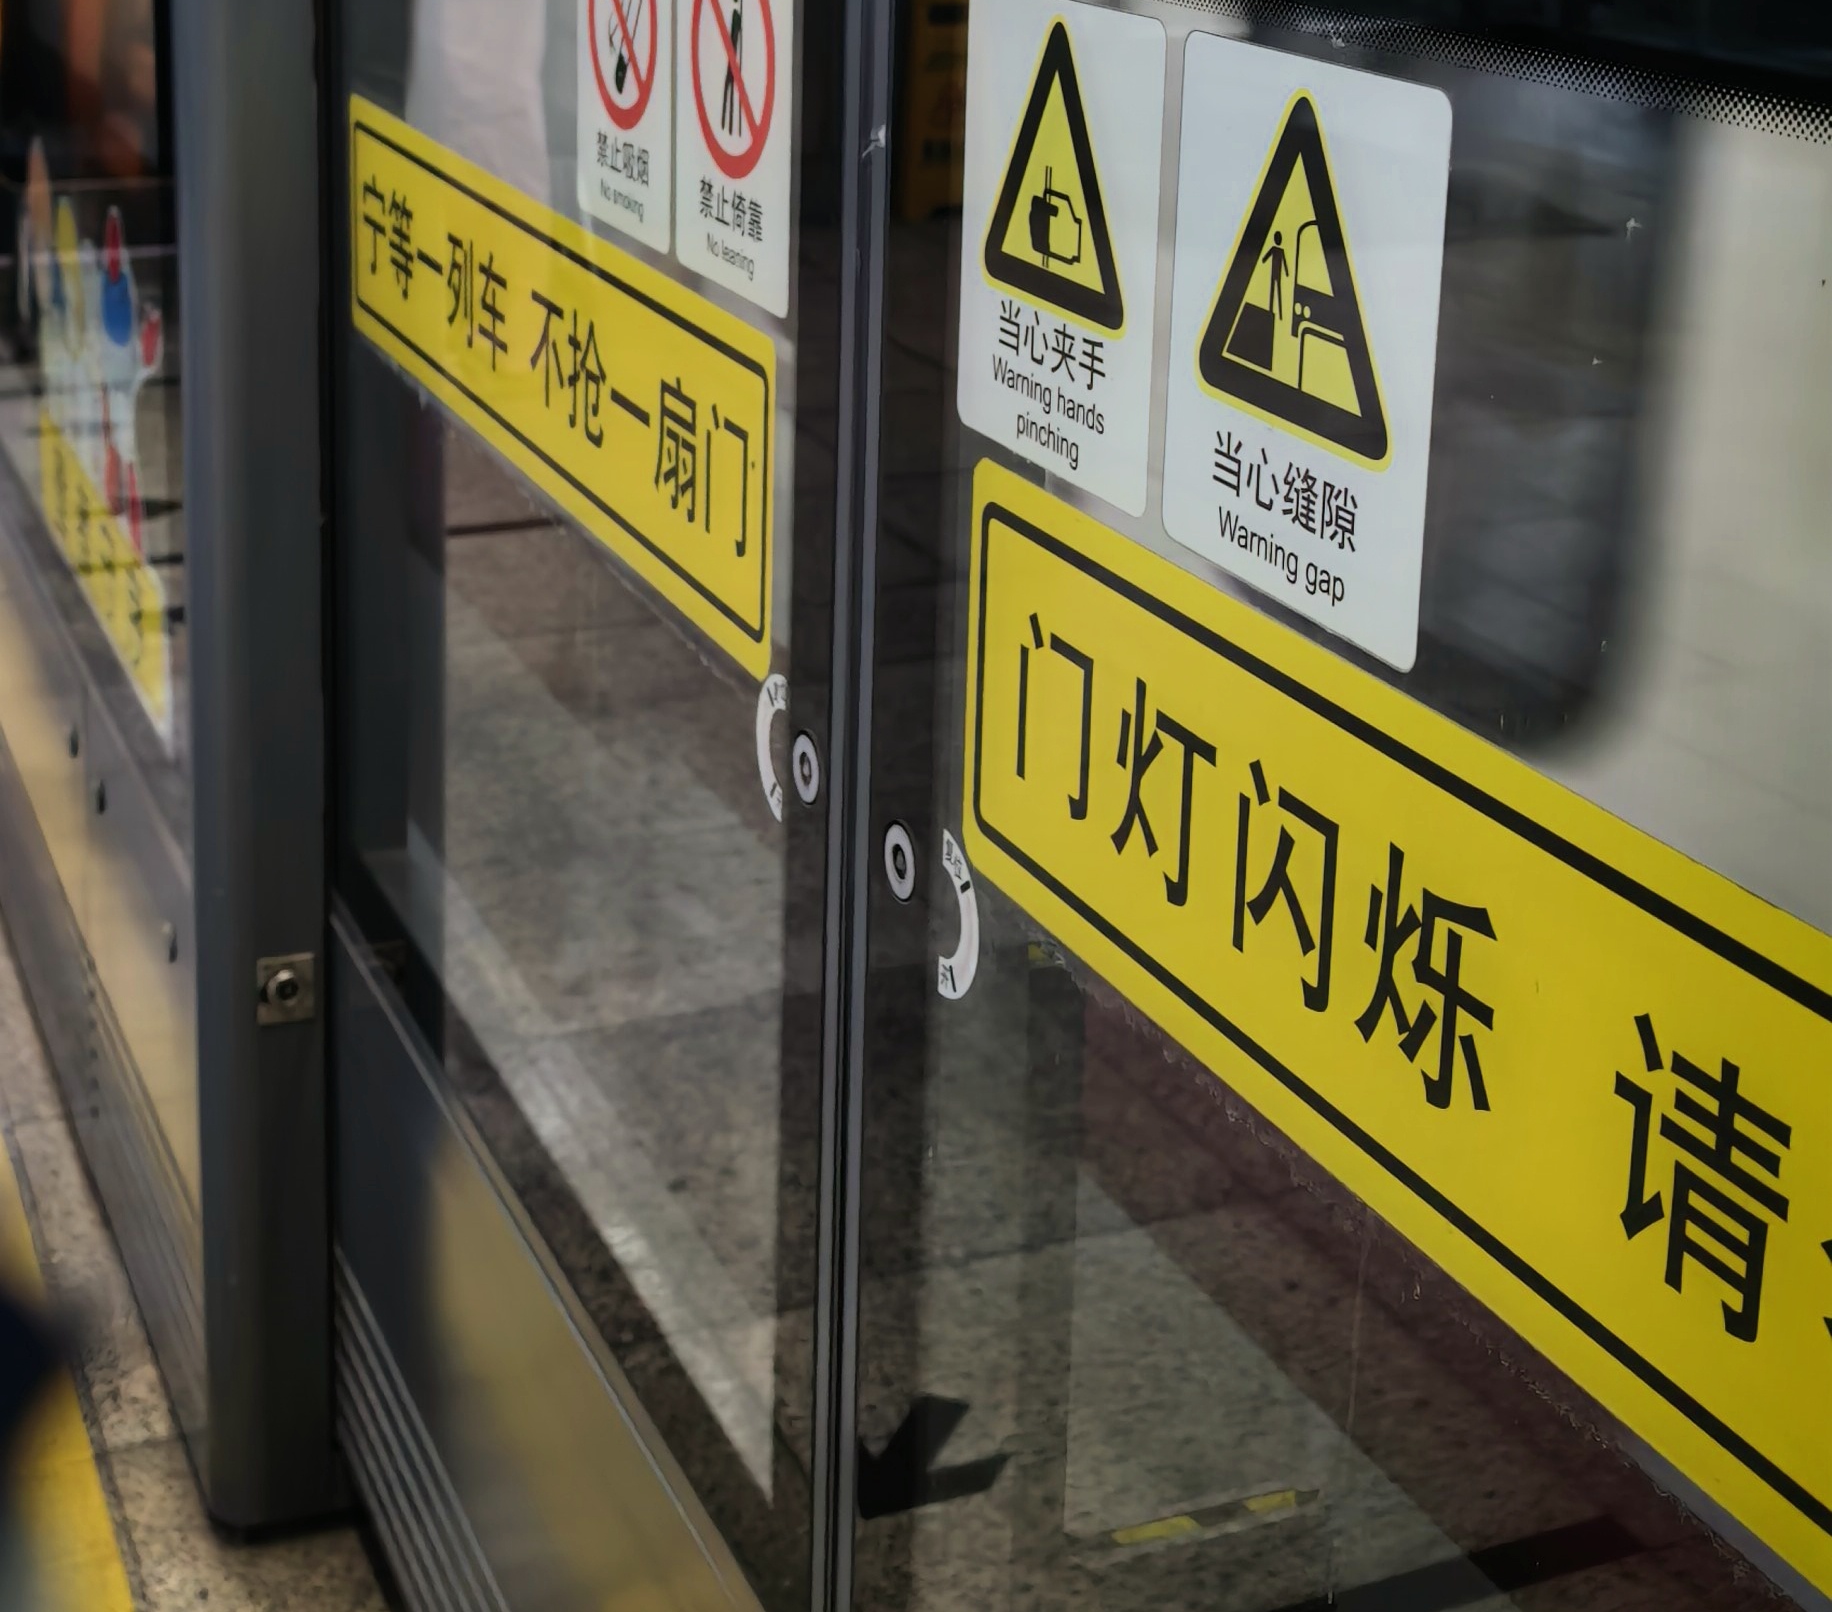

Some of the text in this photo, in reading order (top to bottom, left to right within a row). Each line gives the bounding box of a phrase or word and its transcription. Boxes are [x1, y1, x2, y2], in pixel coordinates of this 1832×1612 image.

[597, 129, 650, 187] 禁止吸烟
[600, 179, 644, 223] No smoking
[699, 174, 763, 243] 禁止倚靠
[707, 233, 754, 281] No leaning
[362, 174, 750, 557] 宁等一列车 不抢一扇门
[998, 300, 1106, 390] 当心夹手
[992, 354, 1106, 435] Warning hands
[1016, 409, 1080, 470] pinching
[1212, 431, 1359, 553] 当心缝隙
[1218, 505, 1346, 607] Warning gap
[1016, 613, 1832, 1343] 门灯闪烁 请
